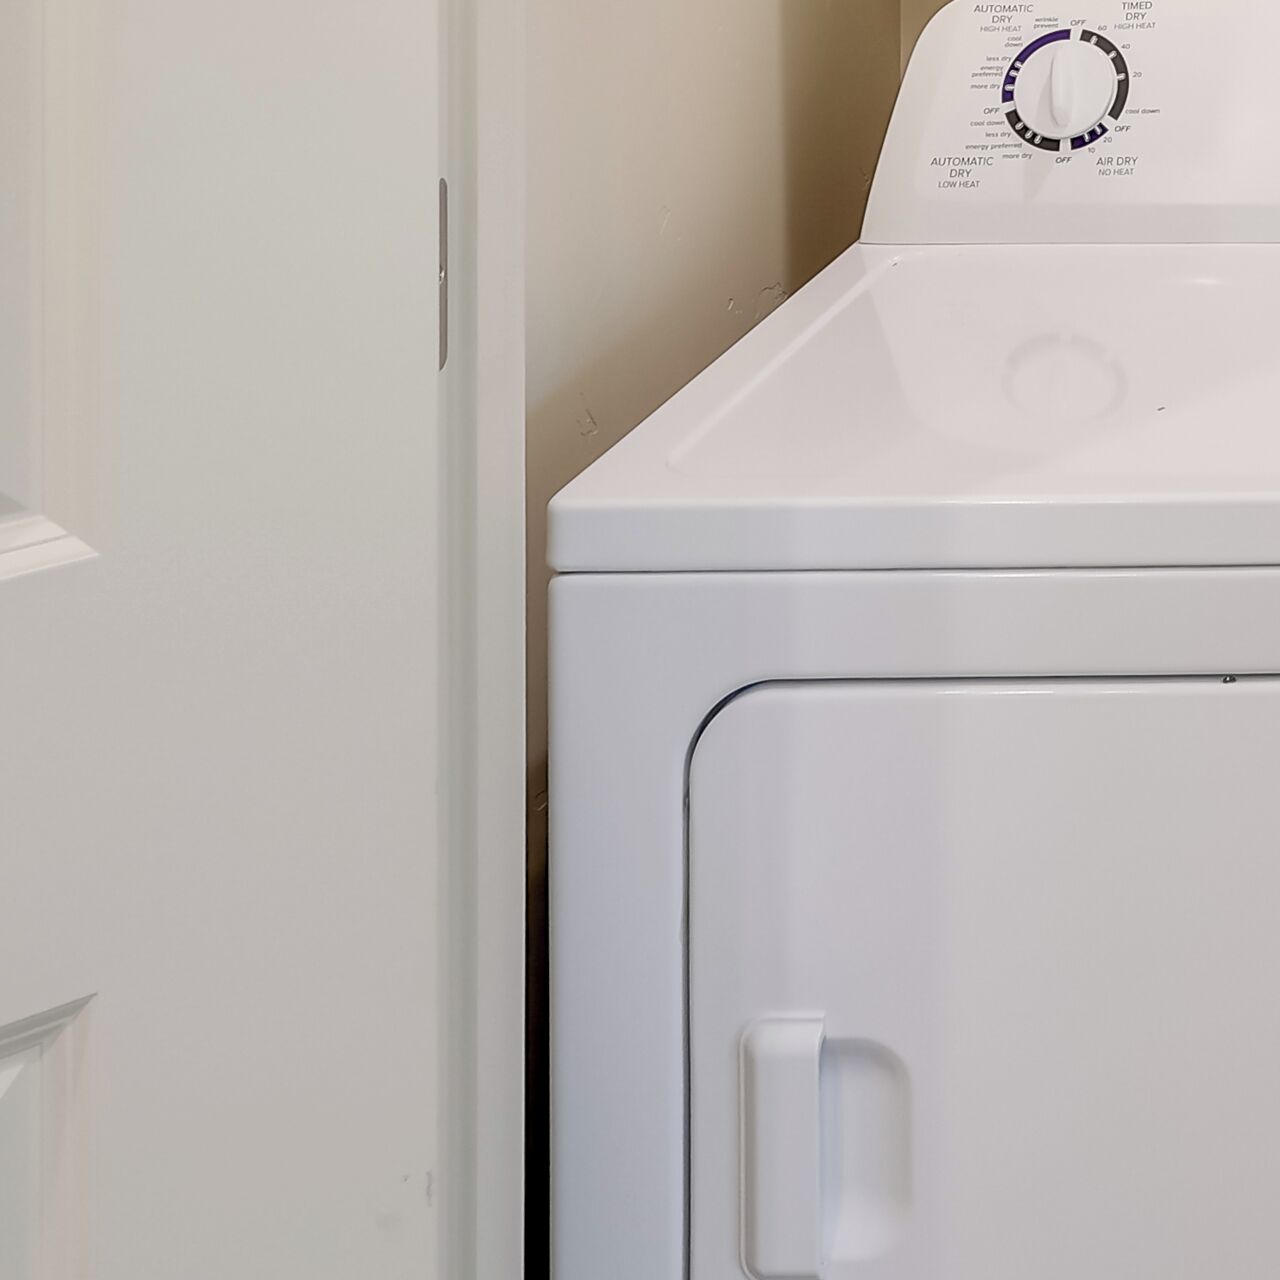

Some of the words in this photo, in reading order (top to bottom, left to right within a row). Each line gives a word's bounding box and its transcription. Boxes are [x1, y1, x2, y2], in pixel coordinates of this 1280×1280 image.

[973, 4, 1034, 13] AUTOMATIC
[1121, 1, 1153, 10] TIMED
[991, 15, 1013, 24] DRY
[1125, 12, 1147, 21] DRY
[983, 107, 1000, 115] OFF
[1000, 131, 1012, 139] dry
[930, 157, 994, 166] AUTOMATIC
[1055, 156, 1073, 164] OFF
[1096, 157, 1113, 166] AIR
[1116, 156, 1139, 166] DRY
[949, 169, 972, 178] DRY
[1098, 168, 1112, 176] NO
[1112, 168, 1135, 176] HEAT
[938, 180, 957, 189] LOW
[958, 180, 980, 188] HEAT
